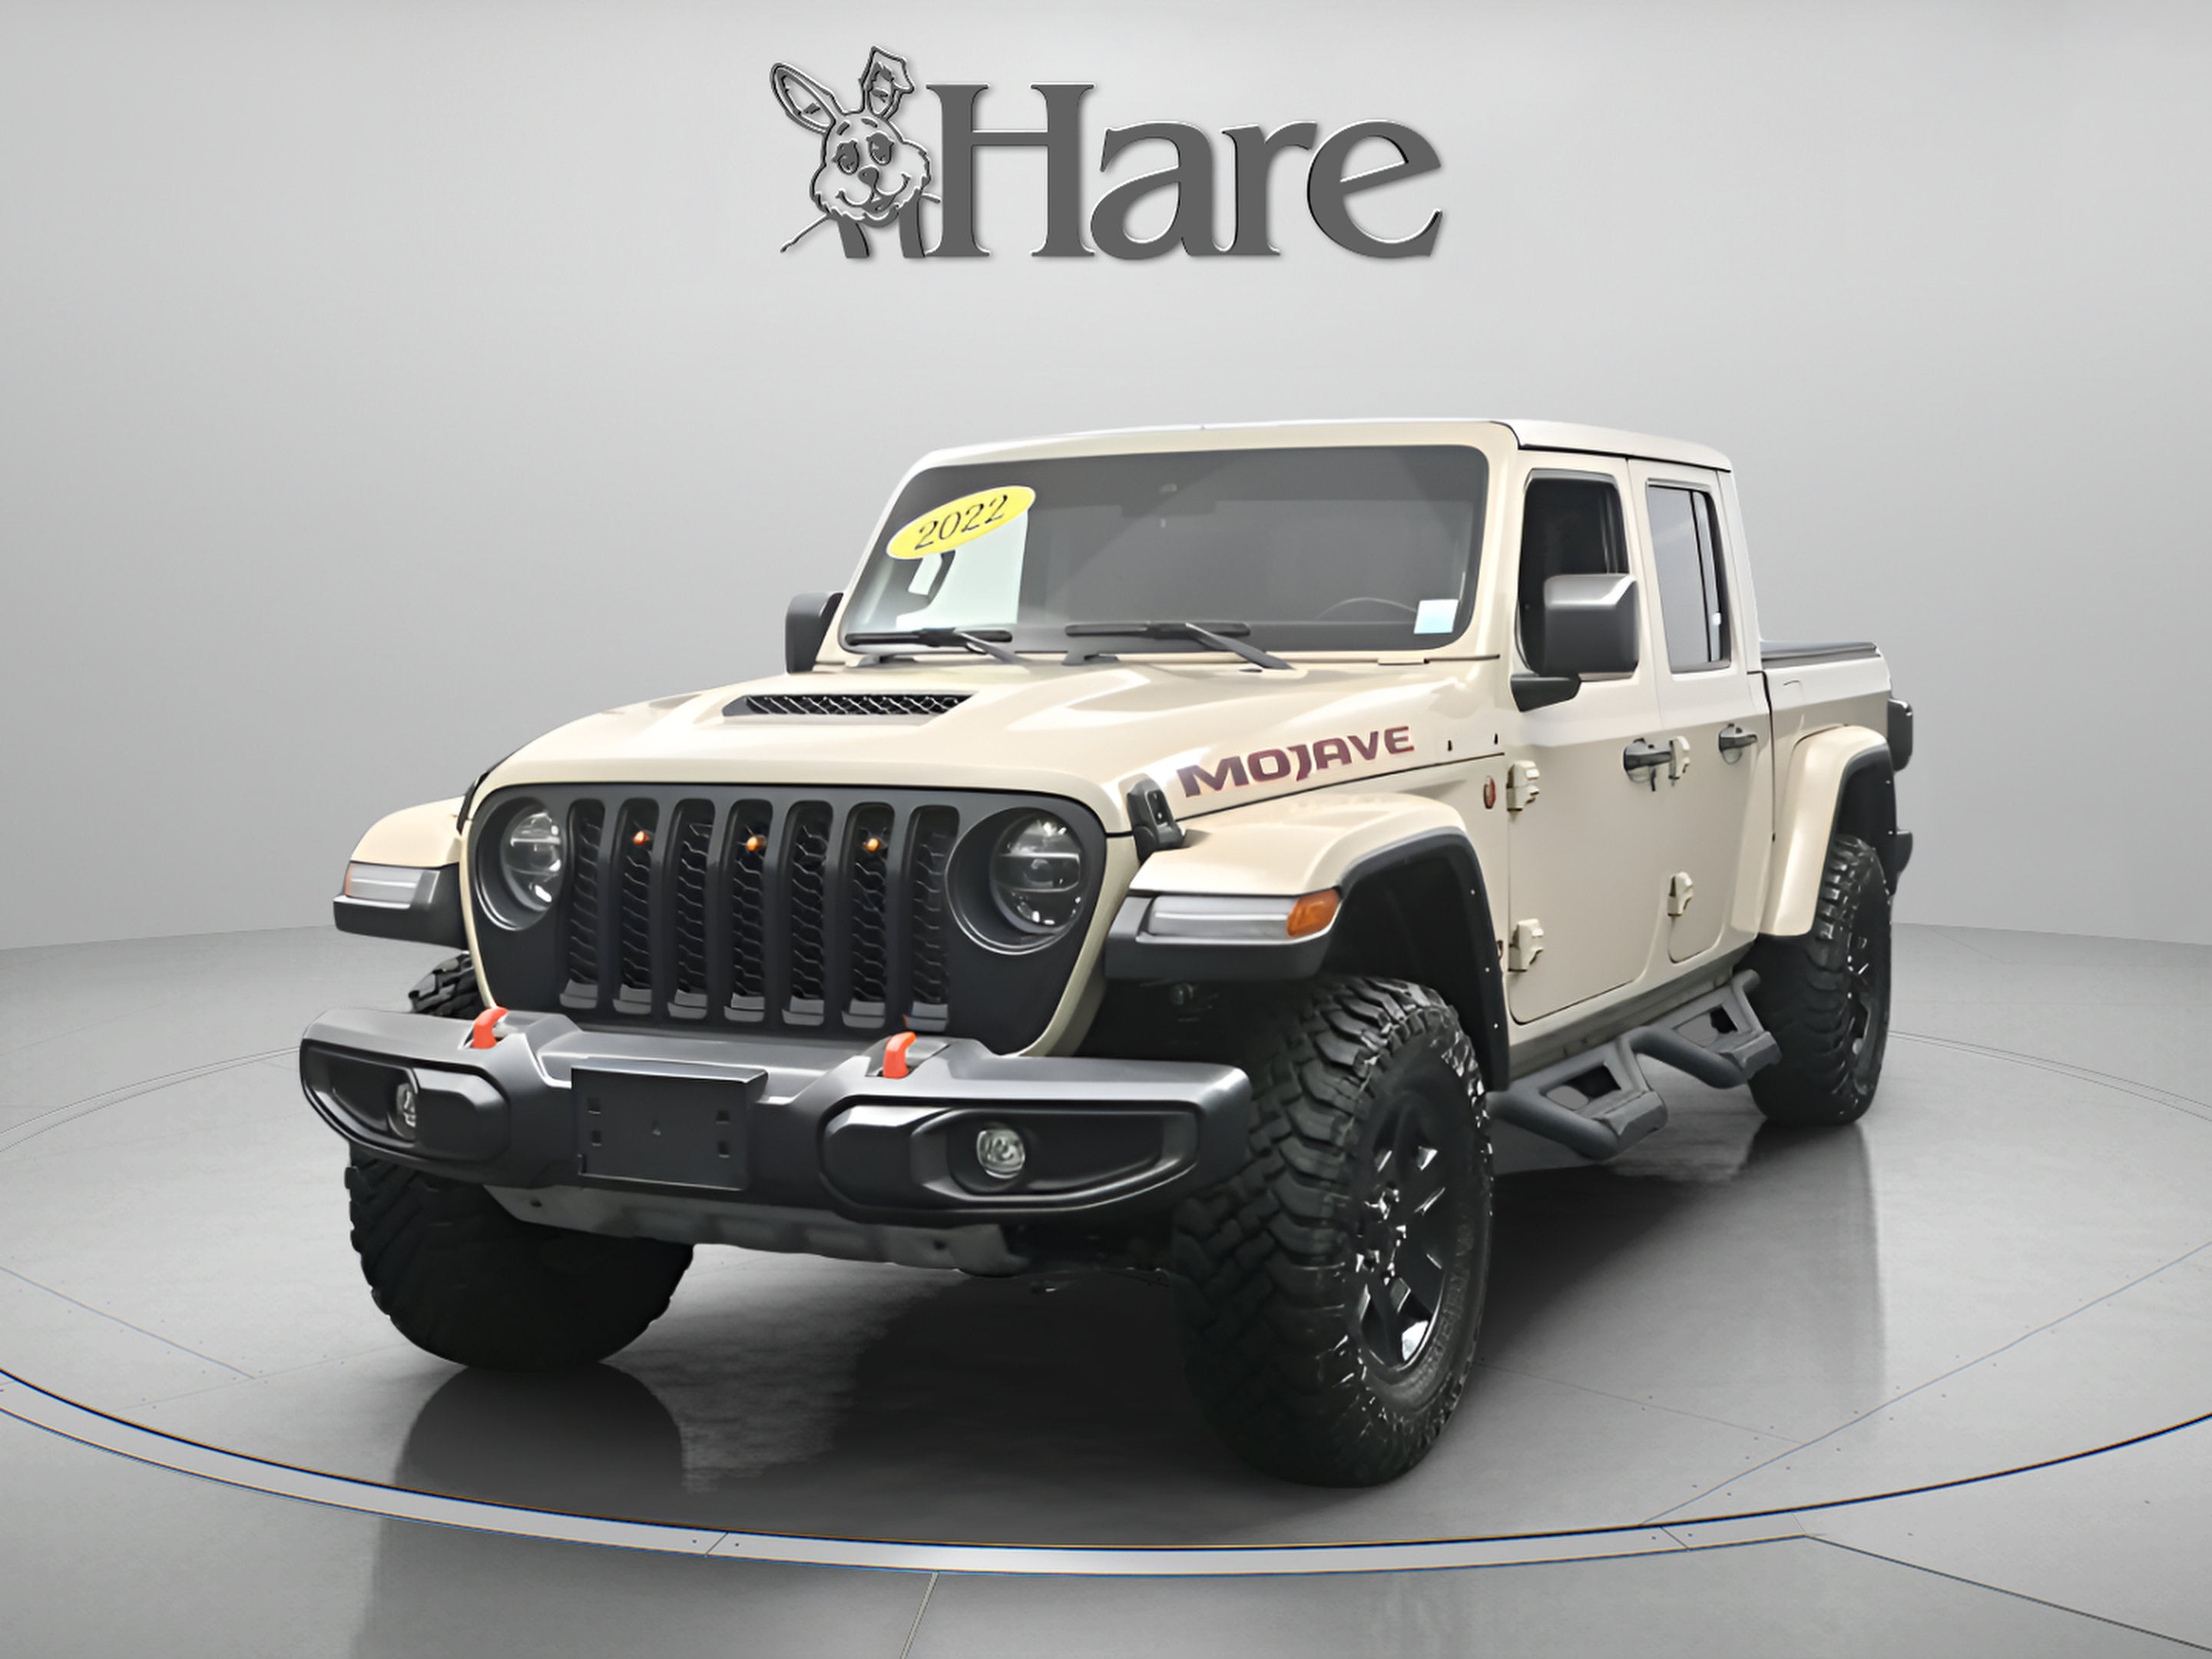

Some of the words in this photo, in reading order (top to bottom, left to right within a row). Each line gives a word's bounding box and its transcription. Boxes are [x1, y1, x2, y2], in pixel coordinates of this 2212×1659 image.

[926, 84, 1443, 258] Hare
[915, 495, 1008, 550] 2022
[1177, 726, 1414, 797] MOJAVE
